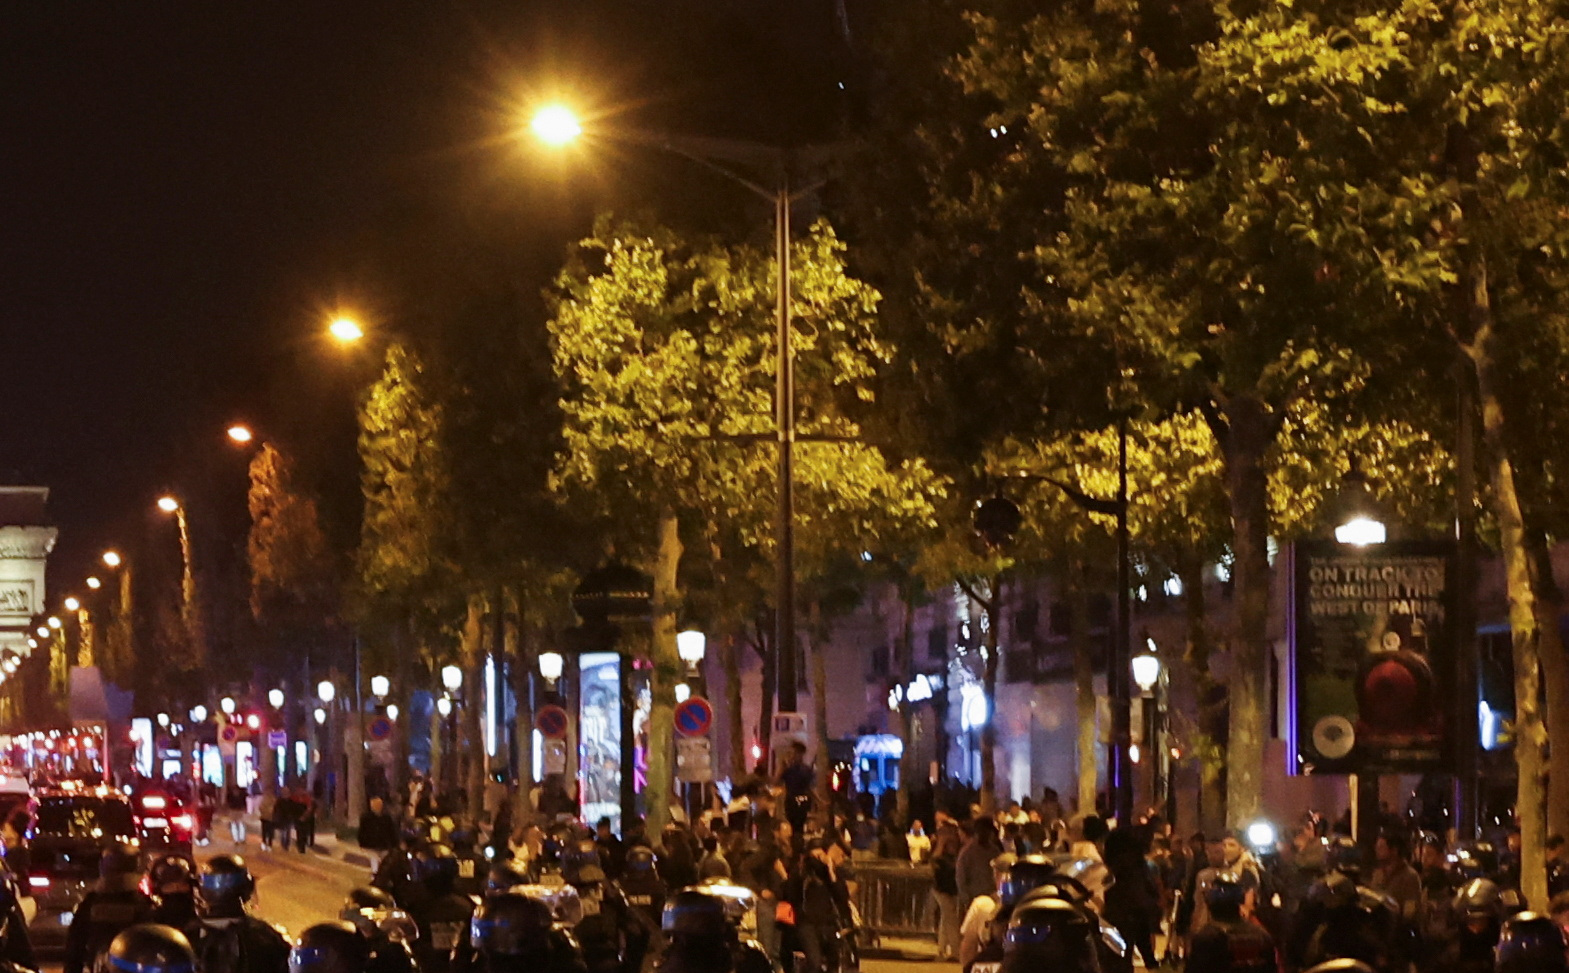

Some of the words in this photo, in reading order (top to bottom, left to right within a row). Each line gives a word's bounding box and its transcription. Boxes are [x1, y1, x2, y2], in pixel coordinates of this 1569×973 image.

[1309, 567, 1338, 582] ON
[1345, 567, 1408, 582] TRACK
[1310, 583, 1400, 598] CONQUER
[1310, 600, 1358, 615] WEST
